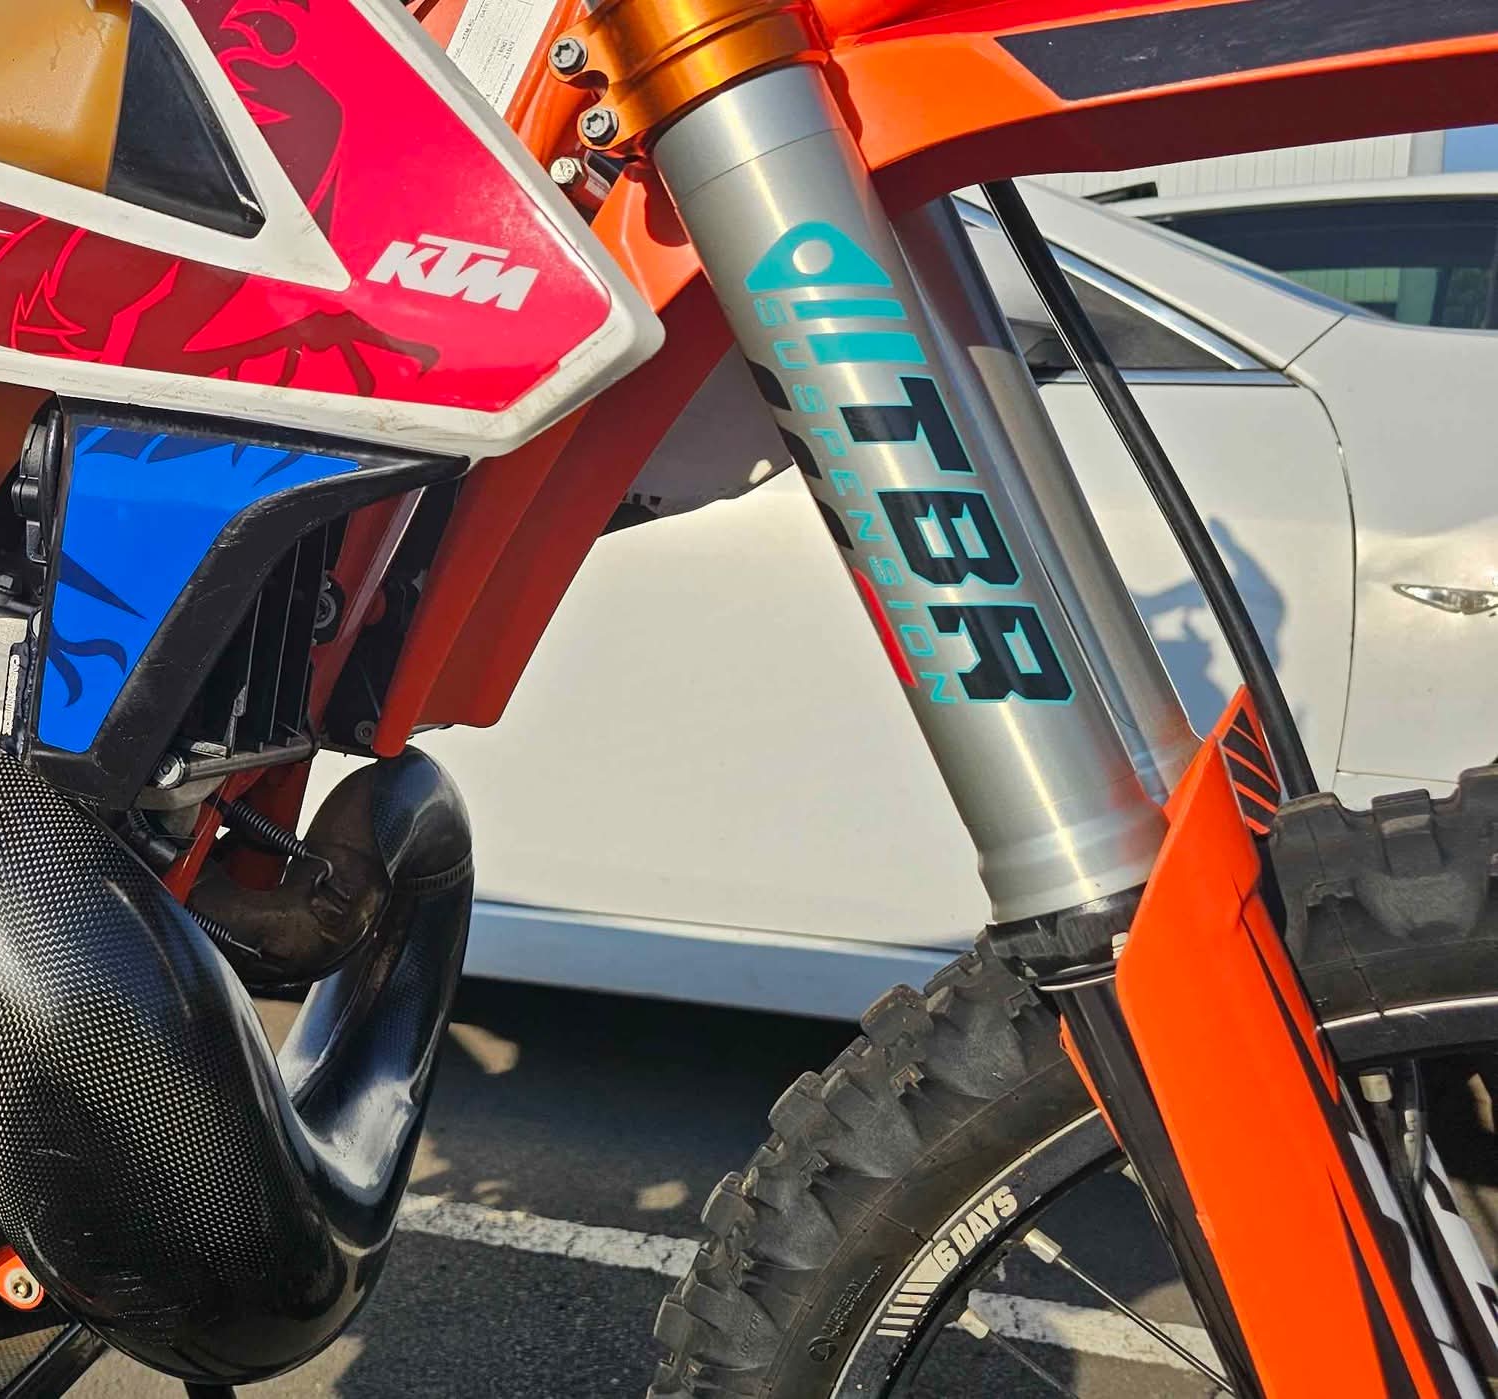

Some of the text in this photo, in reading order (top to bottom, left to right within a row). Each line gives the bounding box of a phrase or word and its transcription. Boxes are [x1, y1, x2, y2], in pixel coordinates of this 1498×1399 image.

[366, 233, 540, 312] KTM
[754, 298, 958, 705] SUSPENSION
[838, 375, 1077, 706] TBR
[932, 1185, 1019, 1272] 6 DAYS
